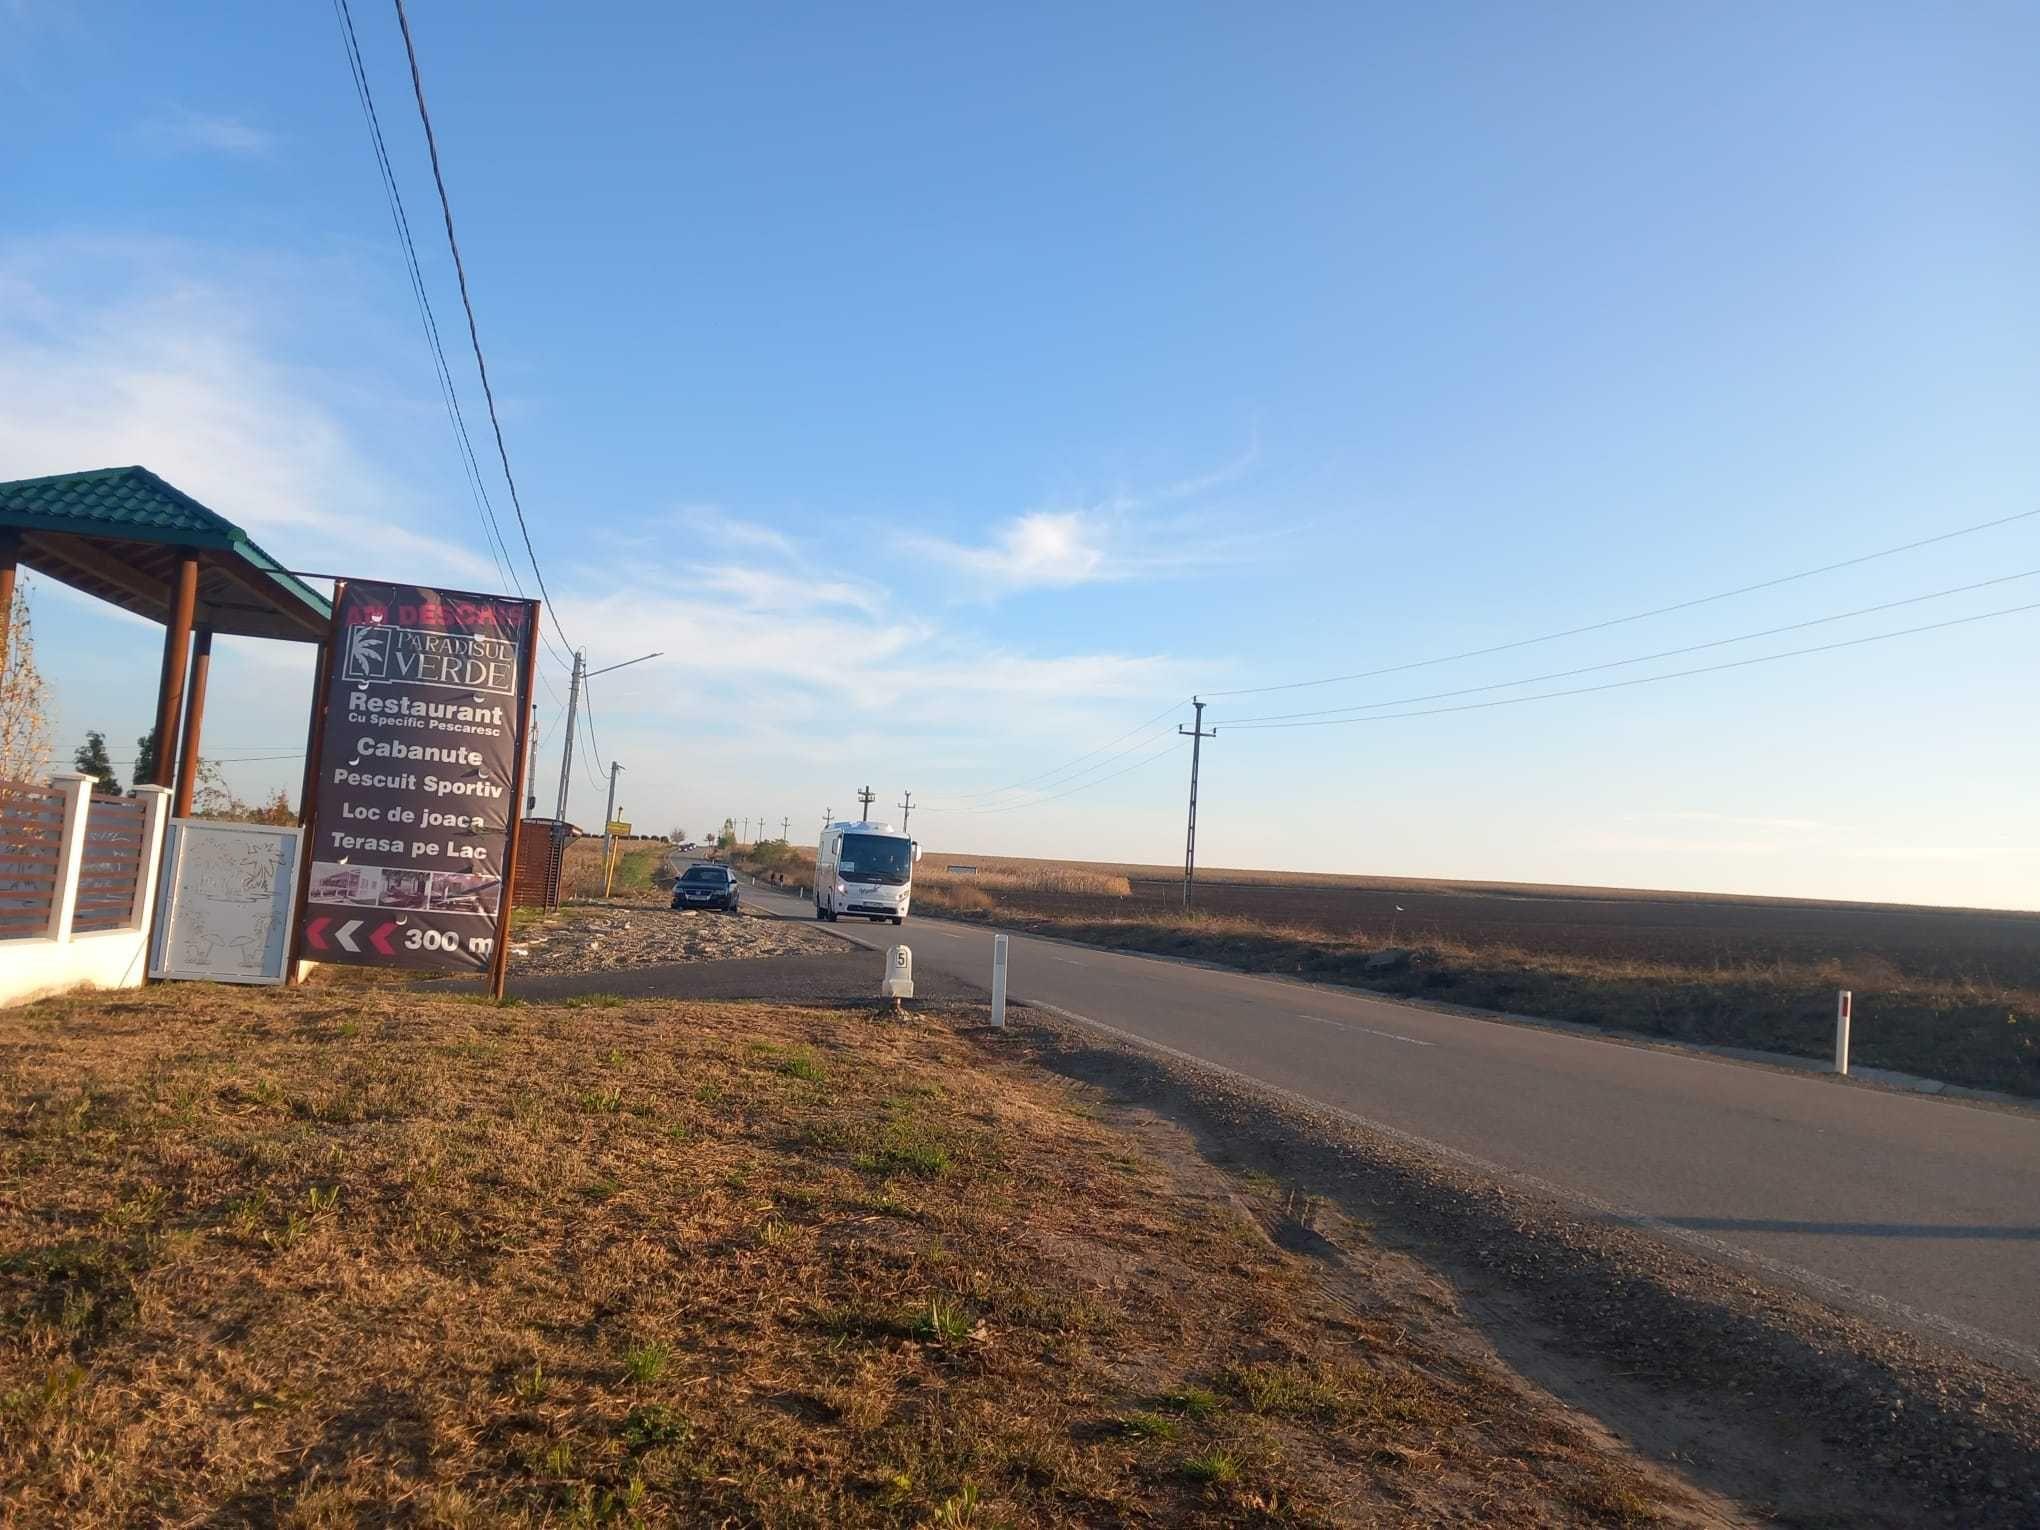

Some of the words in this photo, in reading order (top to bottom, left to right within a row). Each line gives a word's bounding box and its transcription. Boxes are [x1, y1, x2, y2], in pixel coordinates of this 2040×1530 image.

[398, 631, 514, 661] PARADISUL
[395, 652, 512, 688] VERDE
[349, 692, 503, 724] Restaurant
[348, 712, 366, 723] Cu
[370, 715, 425, 730] Specific
[429, 721, 501, 737] Pescaresc
[357, 737, 483, 766] Cabanute
[334, 769, 417, 790] Pescuit
[423, 775, 503, 799] Sportiv
[342, 802, 381, 820] Loc
[387, 806, 416, 823] de
[421, 809, 484, 828] joaca
[331, 832, 404, 852] Terasa
[412, 842, 439, 858] pe
[447, 841, 488, 860] Lac
[404, 929, 460, 951] 300
[469, 937, 495, 954] m
